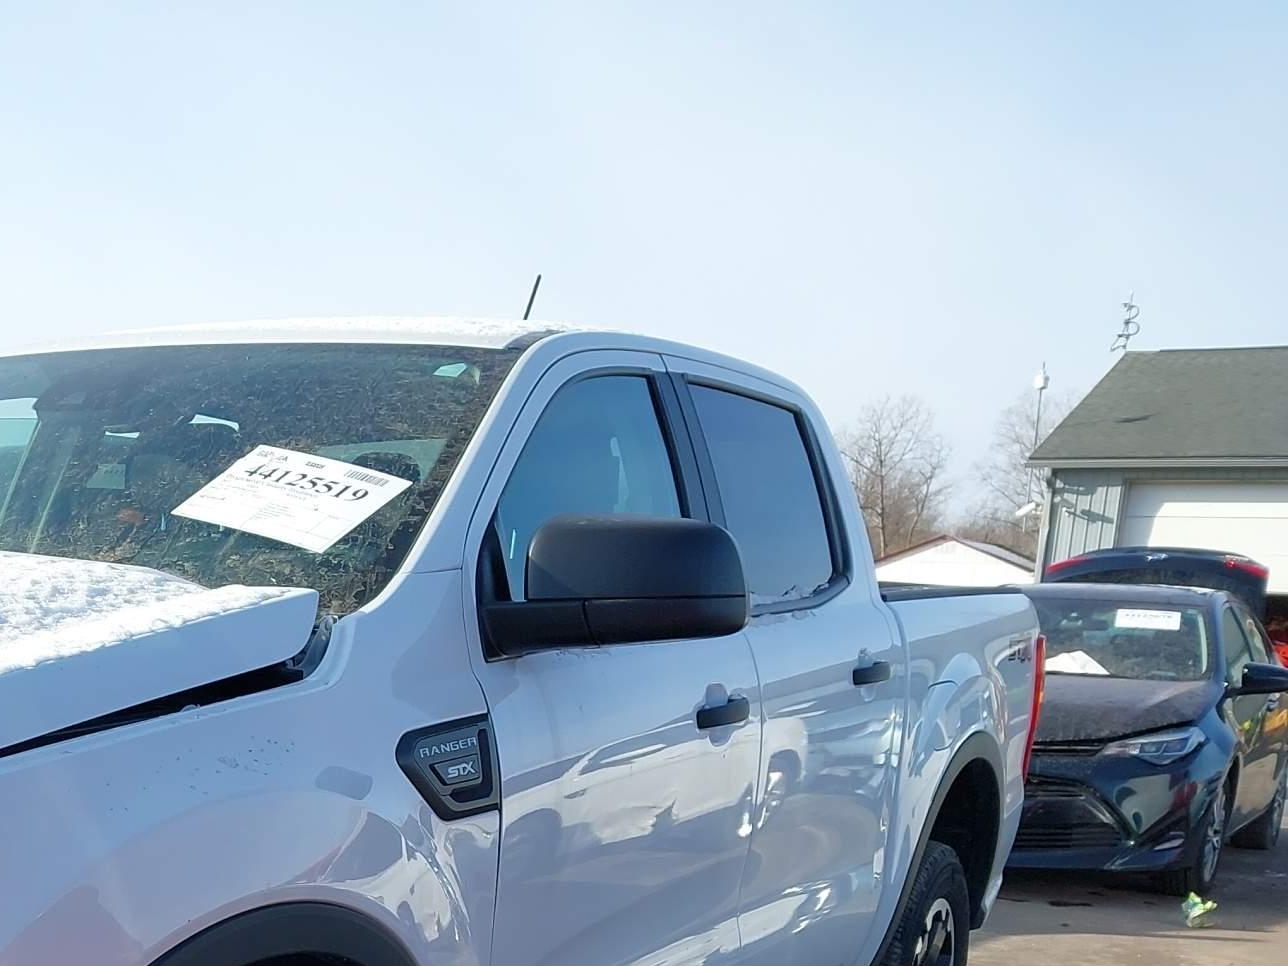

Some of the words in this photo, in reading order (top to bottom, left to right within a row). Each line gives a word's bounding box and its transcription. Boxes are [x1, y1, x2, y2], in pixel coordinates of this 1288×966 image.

[244, 463, 369, 502] 44125519
[419, 736, 477, 758] RANGER
[447, 761, 476, 778] STX
